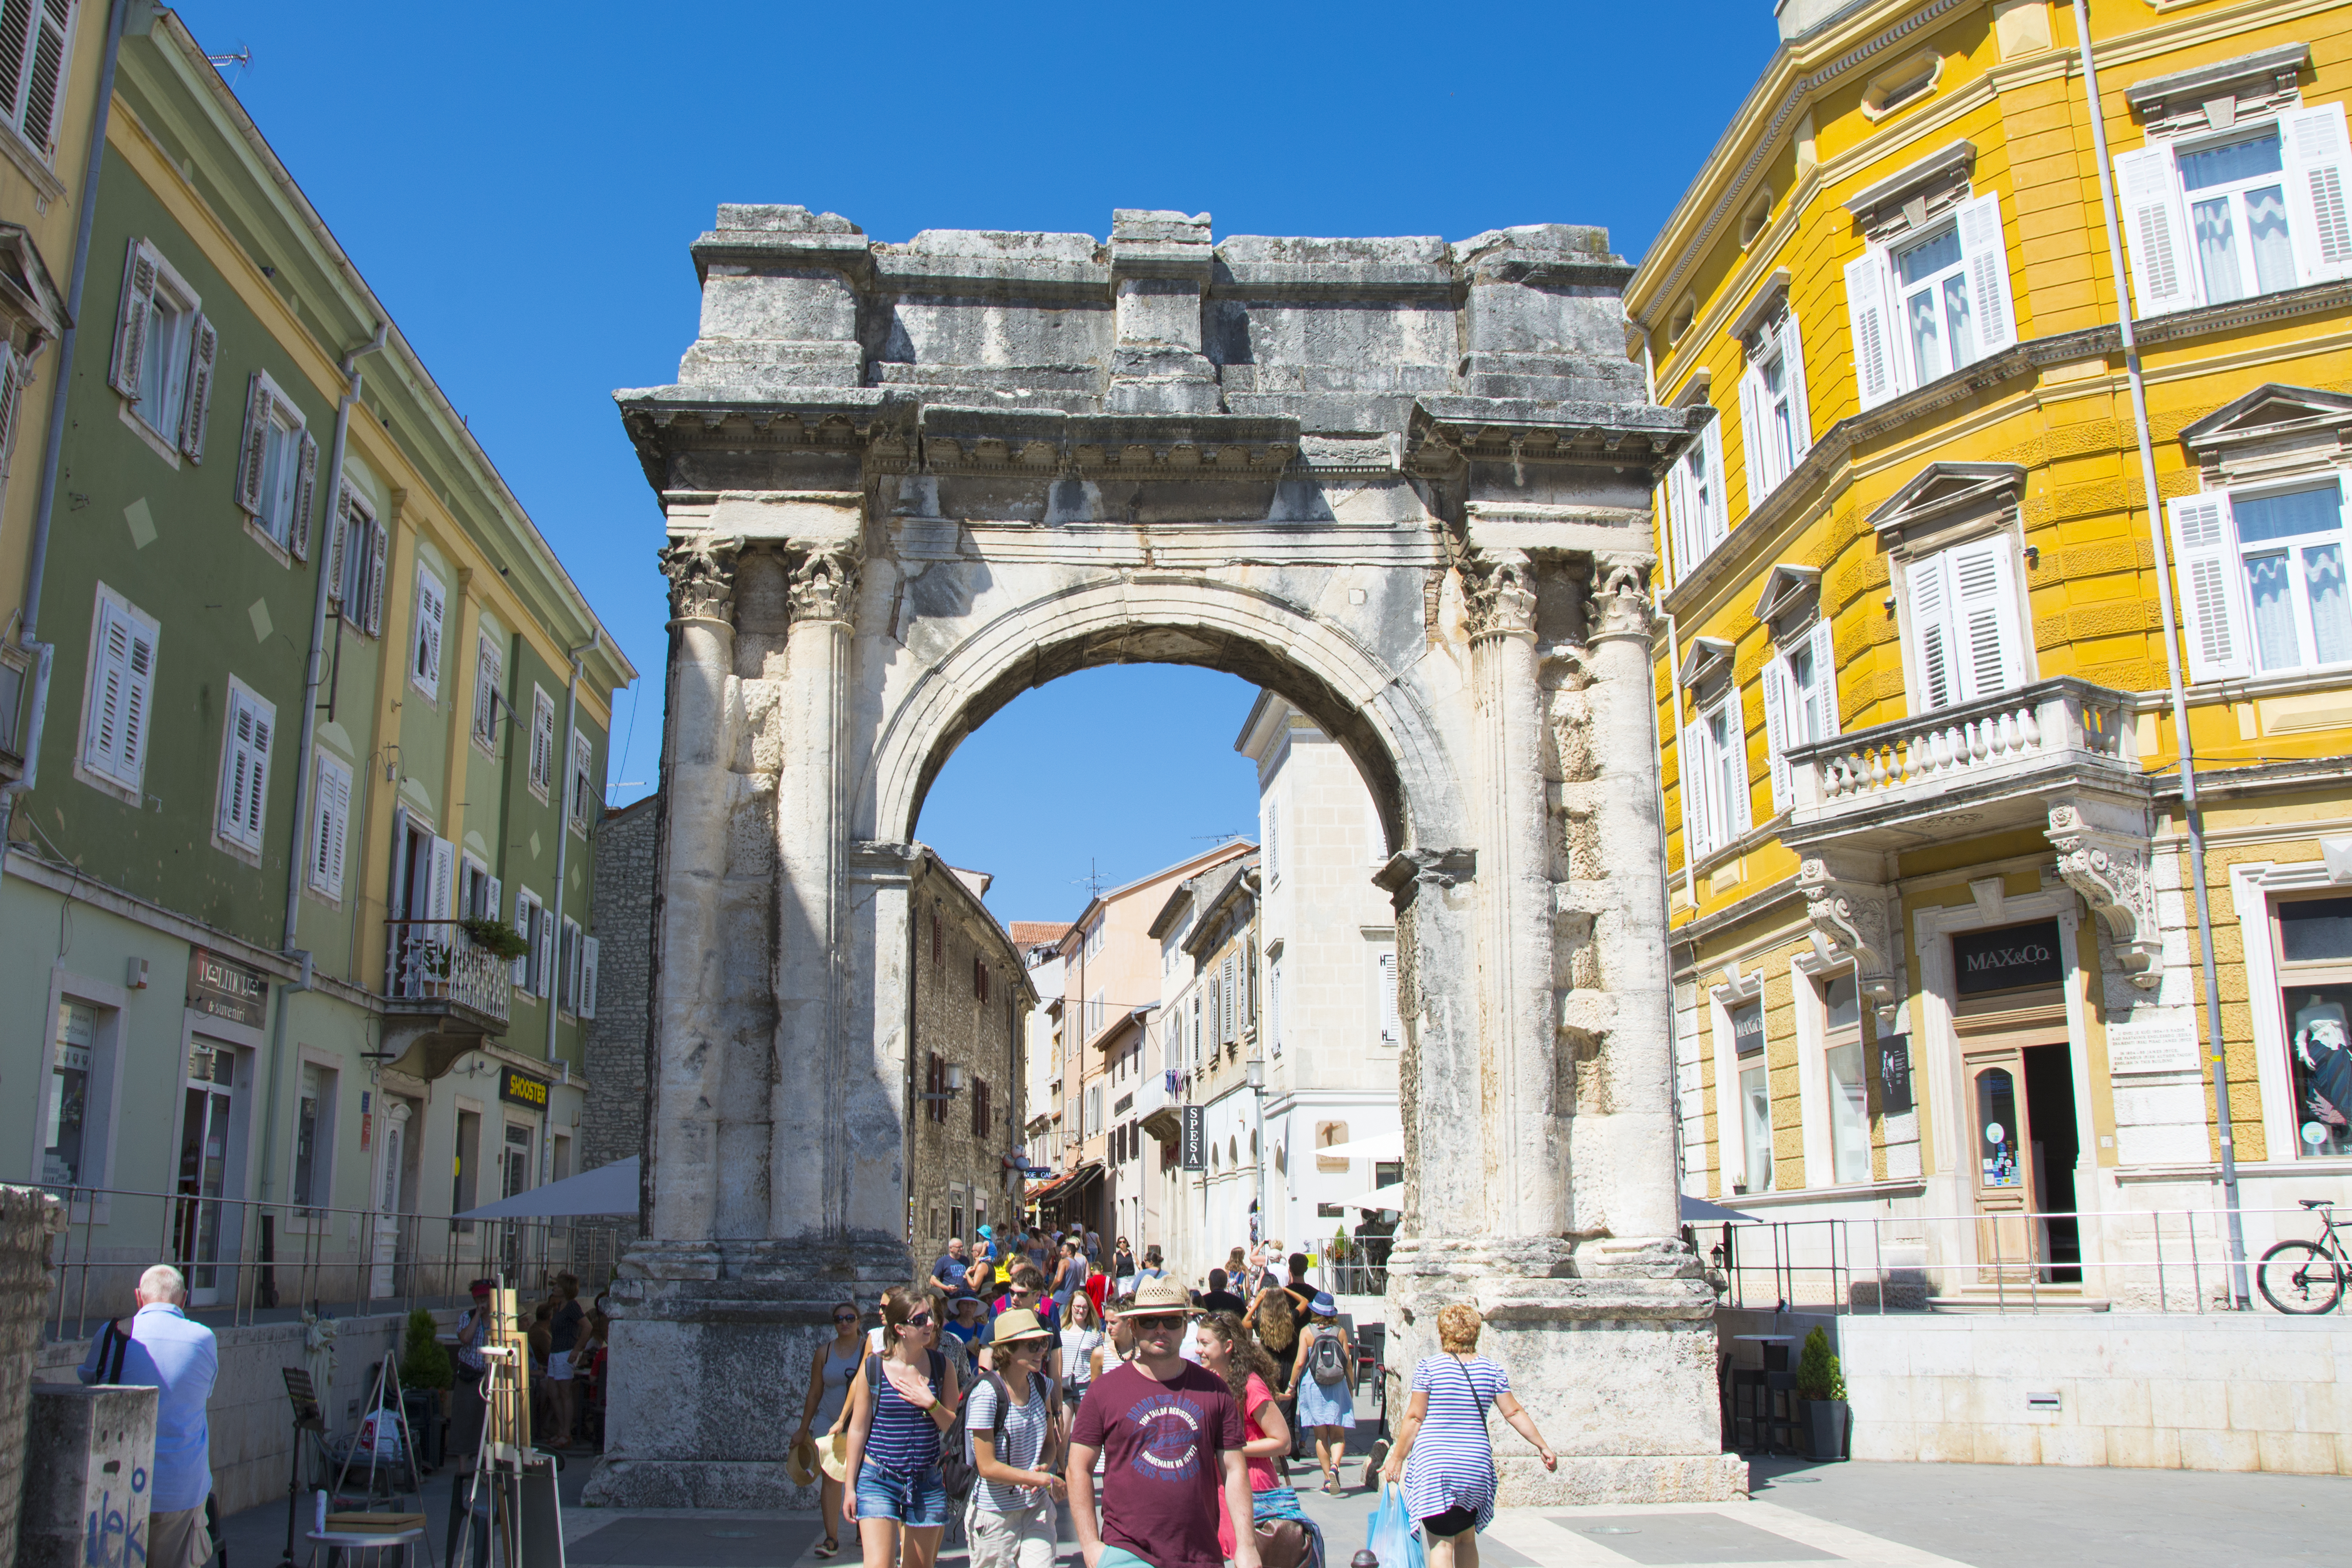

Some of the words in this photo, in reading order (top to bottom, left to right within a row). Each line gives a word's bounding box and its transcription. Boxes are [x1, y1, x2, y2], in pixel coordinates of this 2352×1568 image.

[209, 1001, 214, 1012] &
[216, 1003, 245, 1022] suveniri
[510, 1074, 546, 1105] SHOOSTER
[1189, 1108, 1198, 1163] SPESA
[1126, 1396, 1156, 1422] BRAND
[1139, 1413, 1151, 1426] TOM
[1149, 1407, 1167, 1418] TAILOR
[1169, 1407, 1198, 1431] REGISTERED
[1131, 1456, 1157, 1479] MENS
[1178, 1459, 1201, 1481] WEAR
[1142, 1450, 1175, 1469] TRADEMARK
[1175, 1459, 1183, 1468] NO
